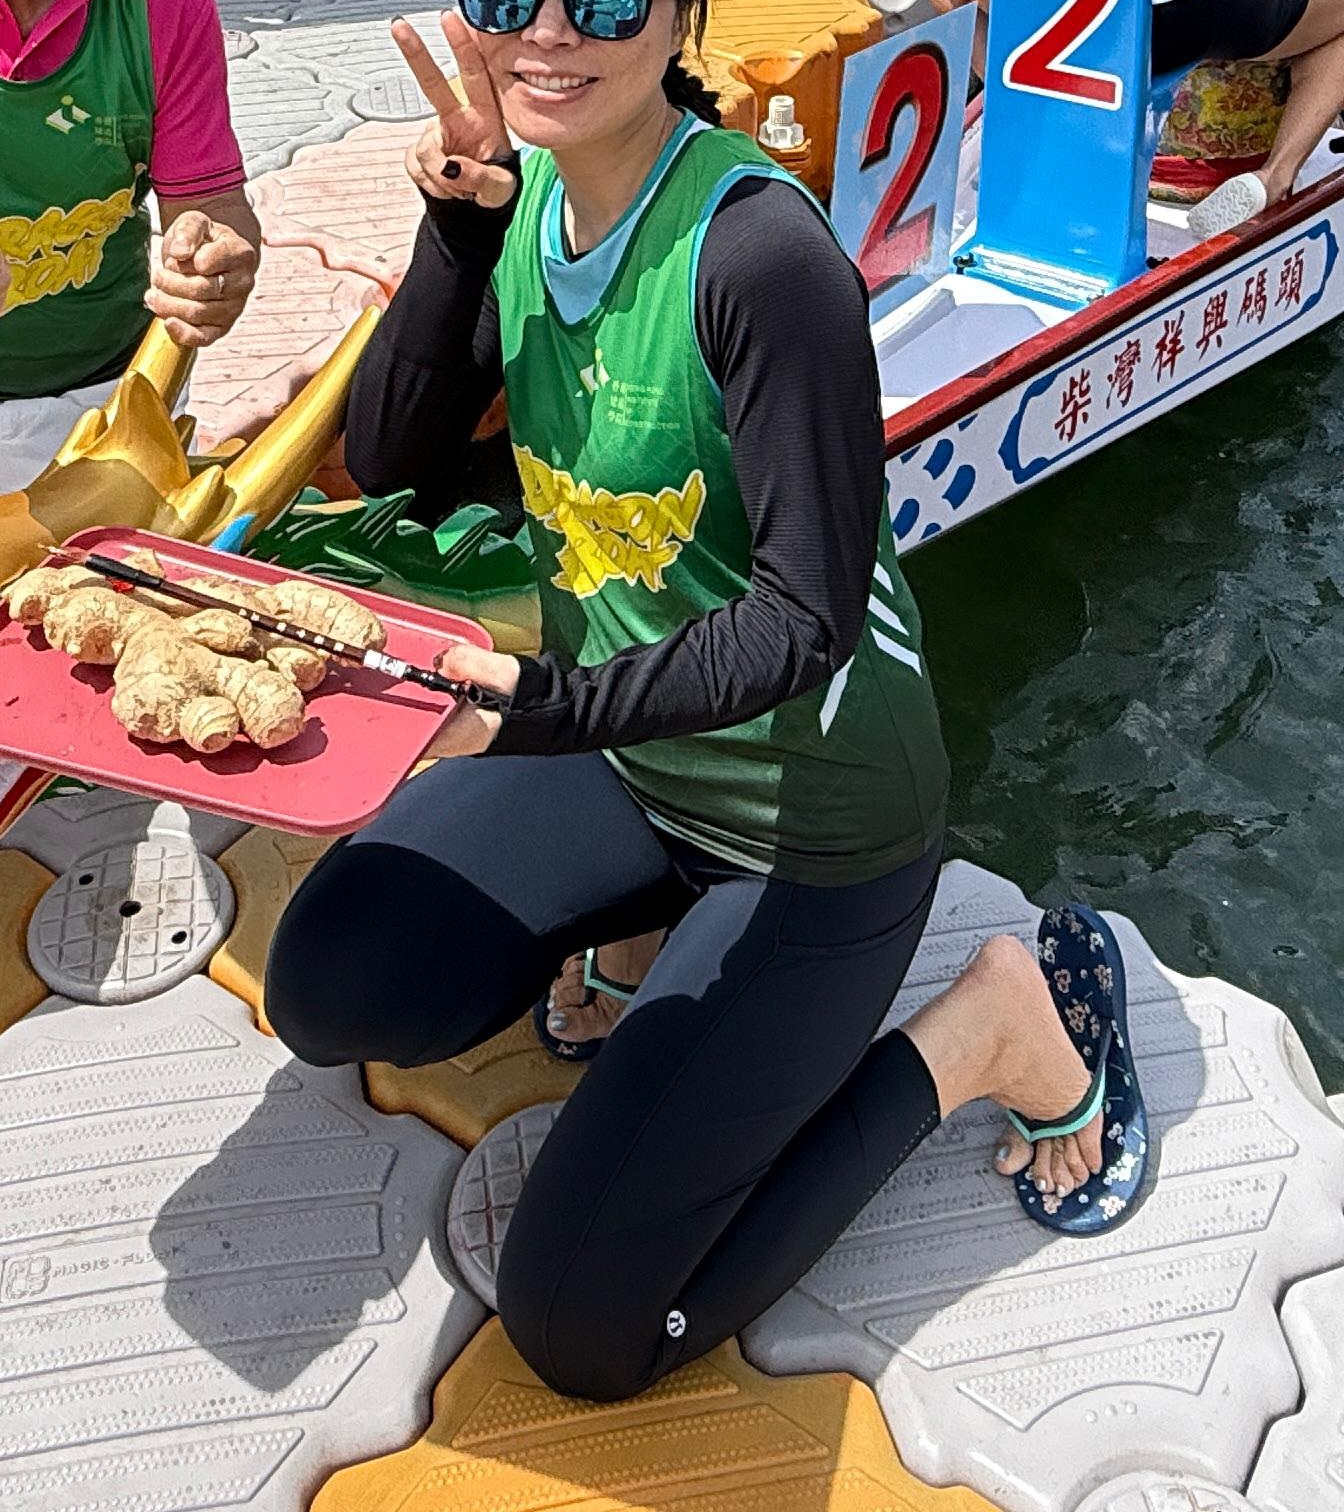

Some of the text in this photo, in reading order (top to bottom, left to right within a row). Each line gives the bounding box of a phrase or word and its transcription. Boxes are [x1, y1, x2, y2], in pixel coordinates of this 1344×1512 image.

[858, 42, 949, 297] 2
[1054, 249, 1305, 443] 柴灣祥興碼頭
